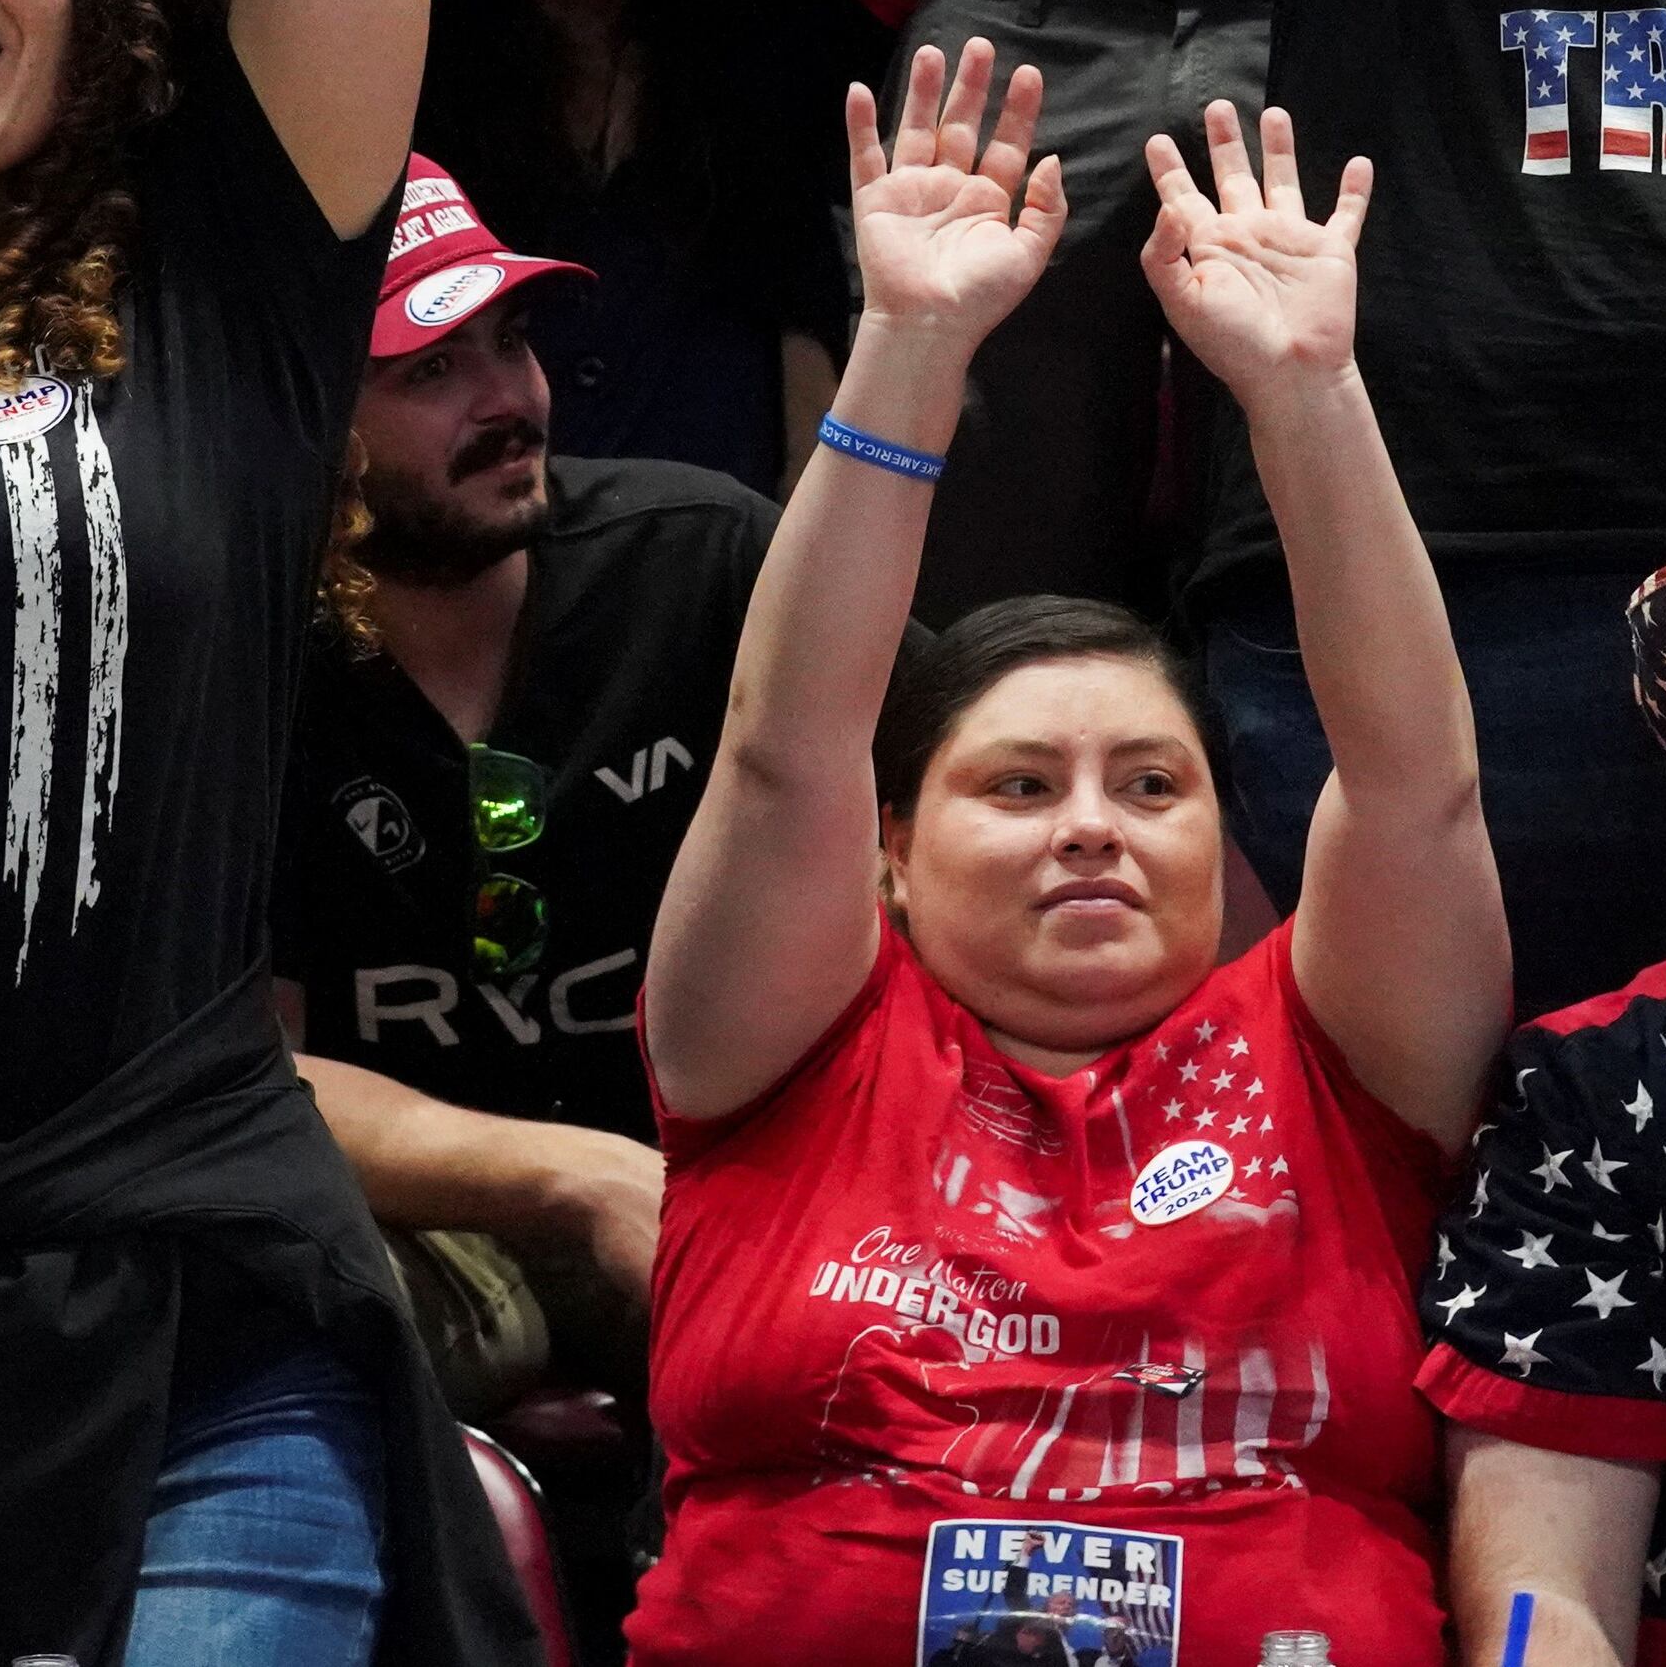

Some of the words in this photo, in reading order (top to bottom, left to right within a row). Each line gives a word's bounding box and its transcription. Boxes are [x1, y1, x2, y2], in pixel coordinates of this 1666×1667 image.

[854, 439, 921, 471] AMERICA
[1133, 1156, 1230, 1213] TRUMP
[1135, 1145, 1215, 1194] TEAM
[1165, 1186, 1213, 1216] 2024
[849, 1224, 922, 1265] One
[808, 1260, 959, 1326] UNDER
[966, 1307, 1061, 1356] GOD
[953, 1529, 1157, 1575] NEVER
